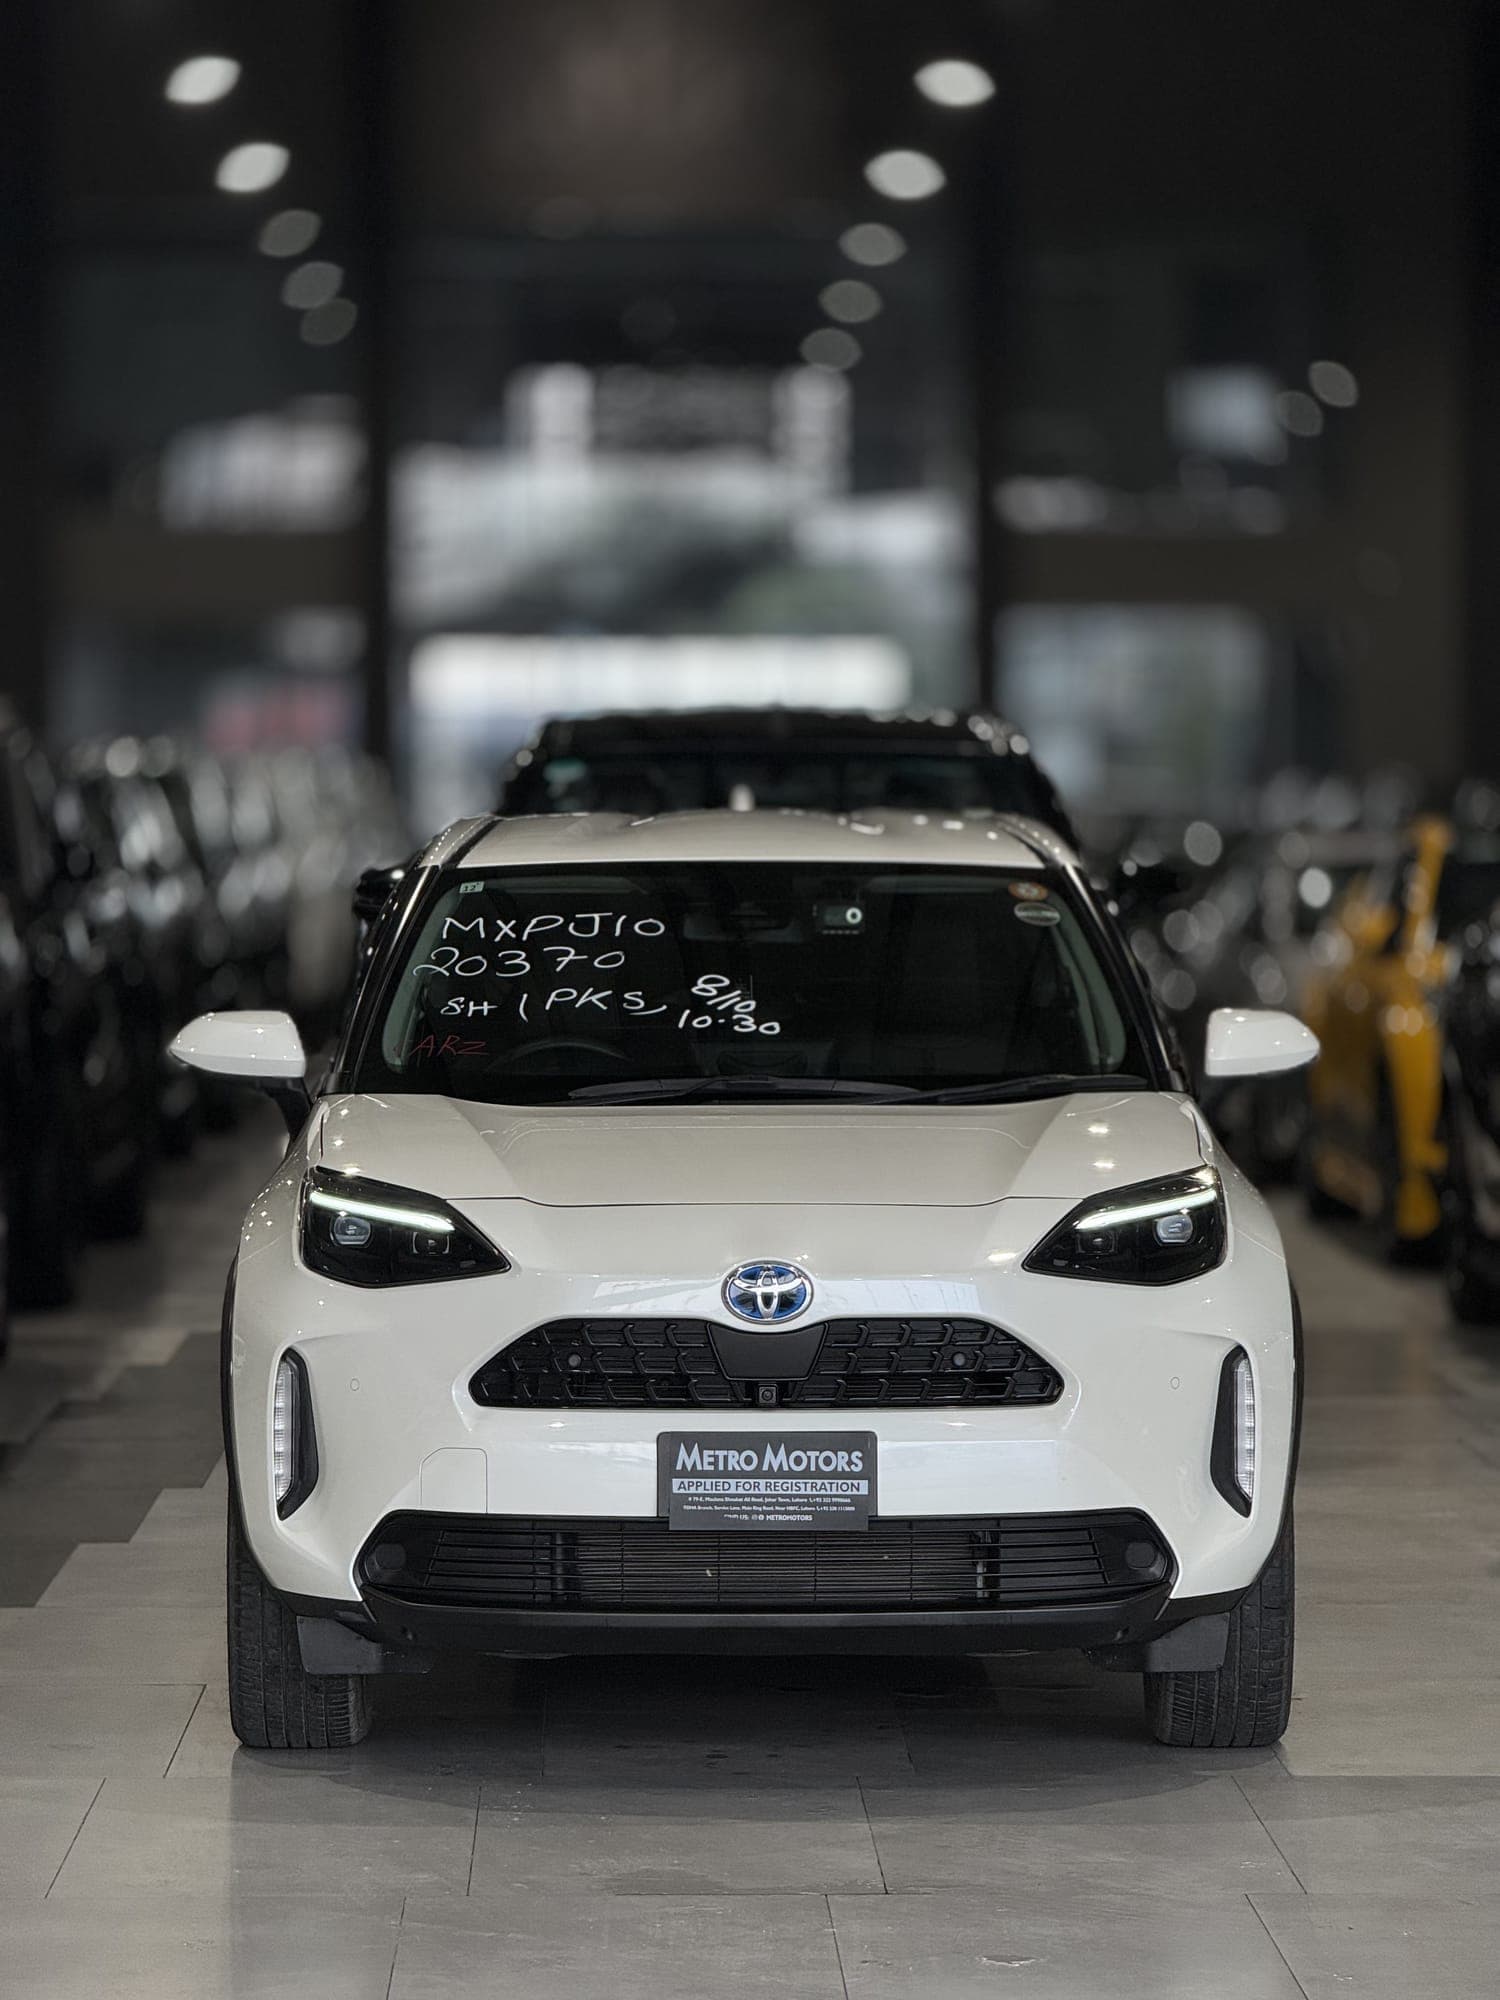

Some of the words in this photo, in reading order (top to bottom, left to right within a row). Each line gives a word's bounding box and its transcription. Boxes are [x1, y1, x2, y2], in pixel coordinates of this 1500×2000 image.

[412, 945, 626, 978] 20370
[675, 1441, 758, 1472] METRO
[762, 1441, 864, 1473] MOTORS
[677, 1481, 732, 1492] APPLIED
[735, 1481, 761, 1492] FOR
[765, 1481, 861, 1493] REGISTRATION
